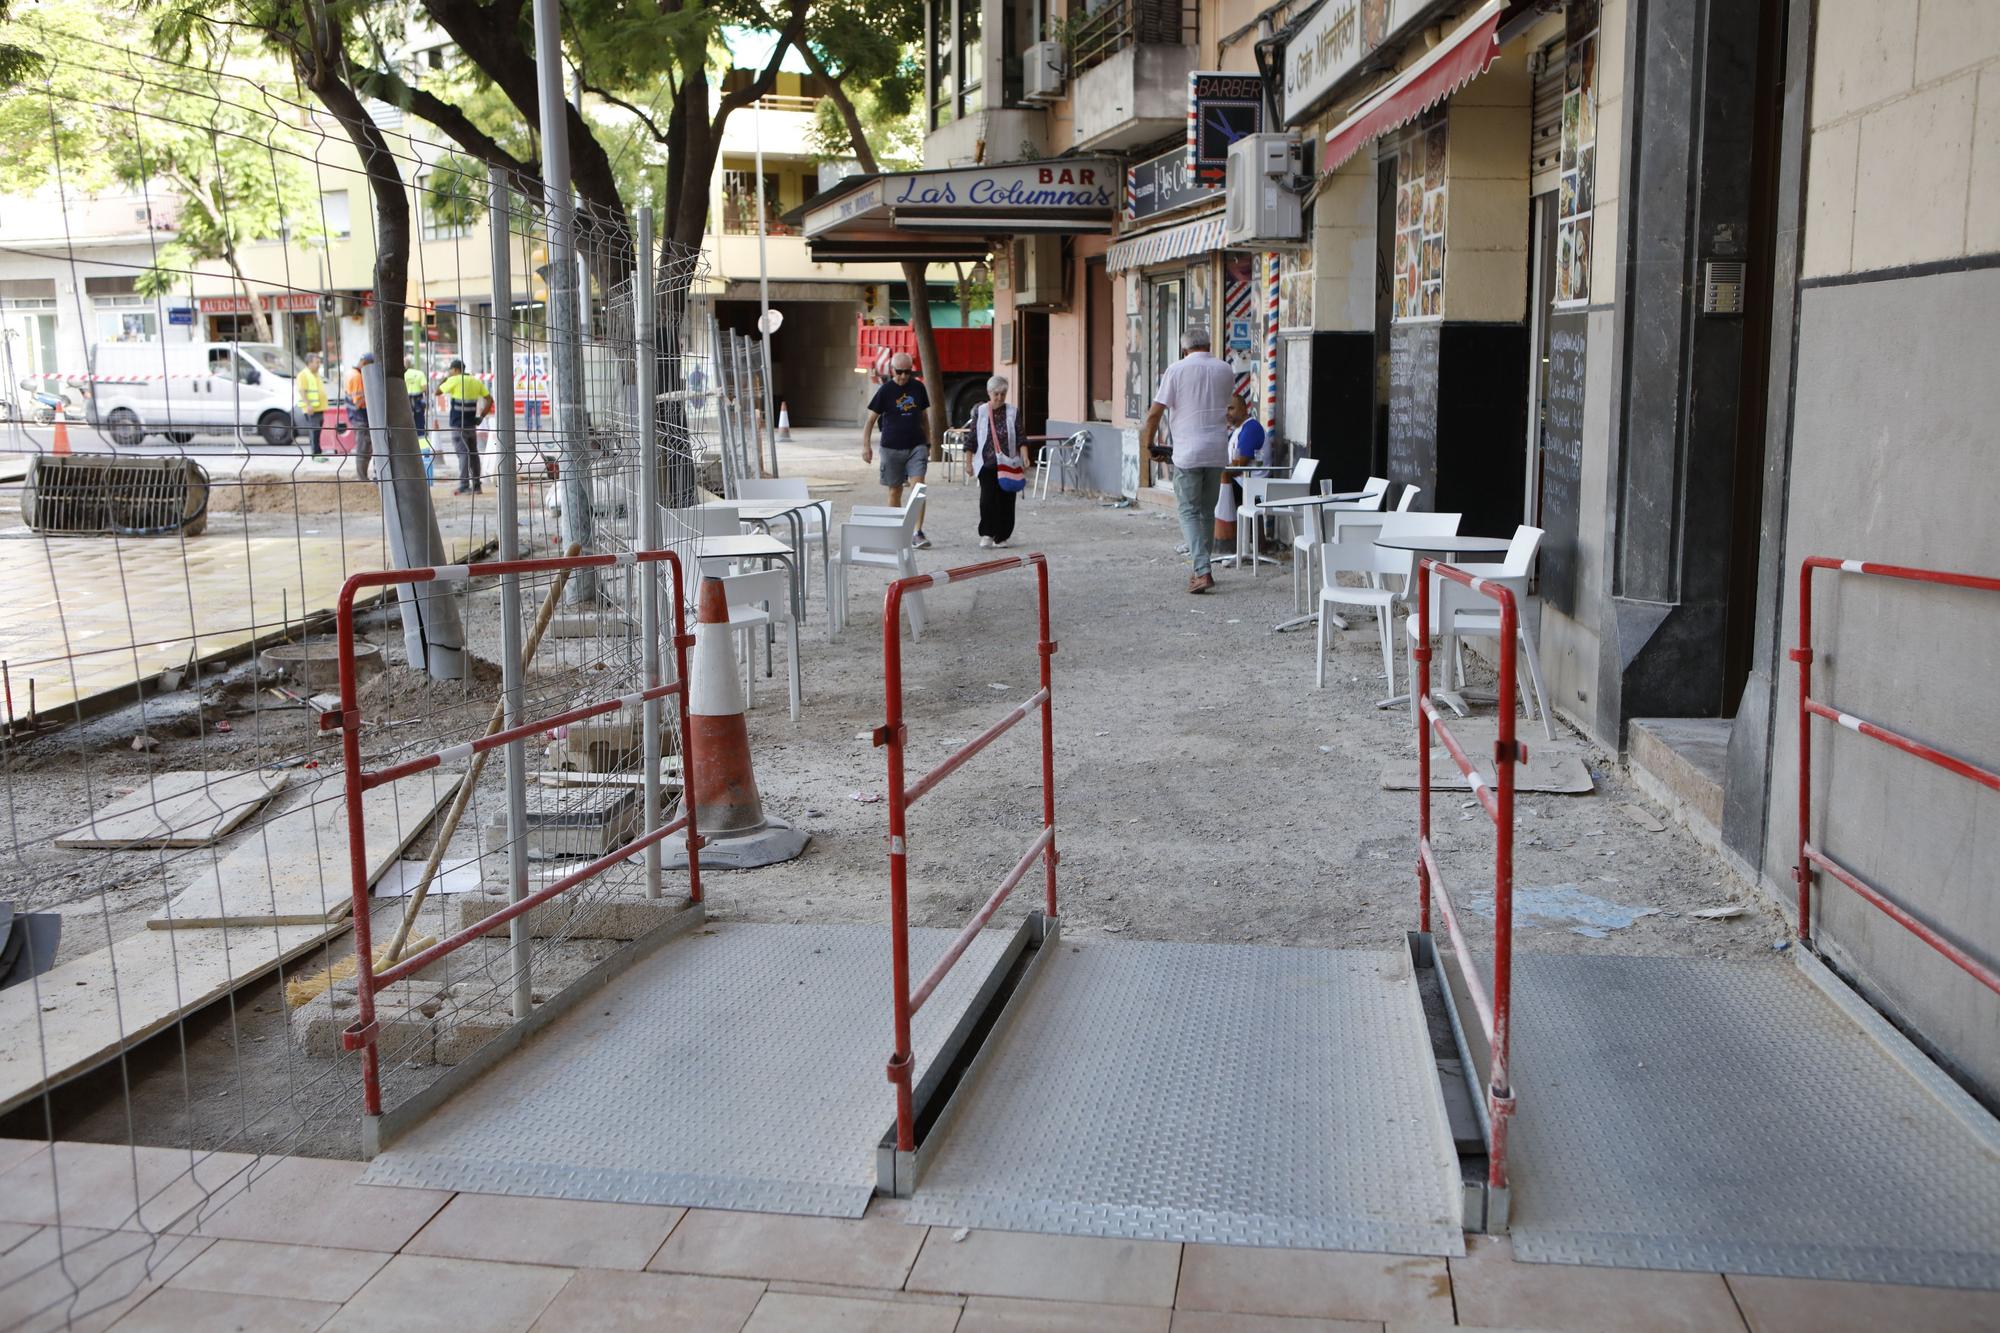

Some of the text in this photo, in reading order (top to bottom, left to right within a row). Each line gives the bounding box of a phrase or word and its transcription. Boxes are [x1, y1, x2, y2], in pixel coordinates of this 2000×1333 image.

[1198, 78, 1262, 98] BARBER
[1038, 168, 1095, 186] BAR
[896, 177, 956, 204] Las
[969, 179, 1114, 206] Columnas
